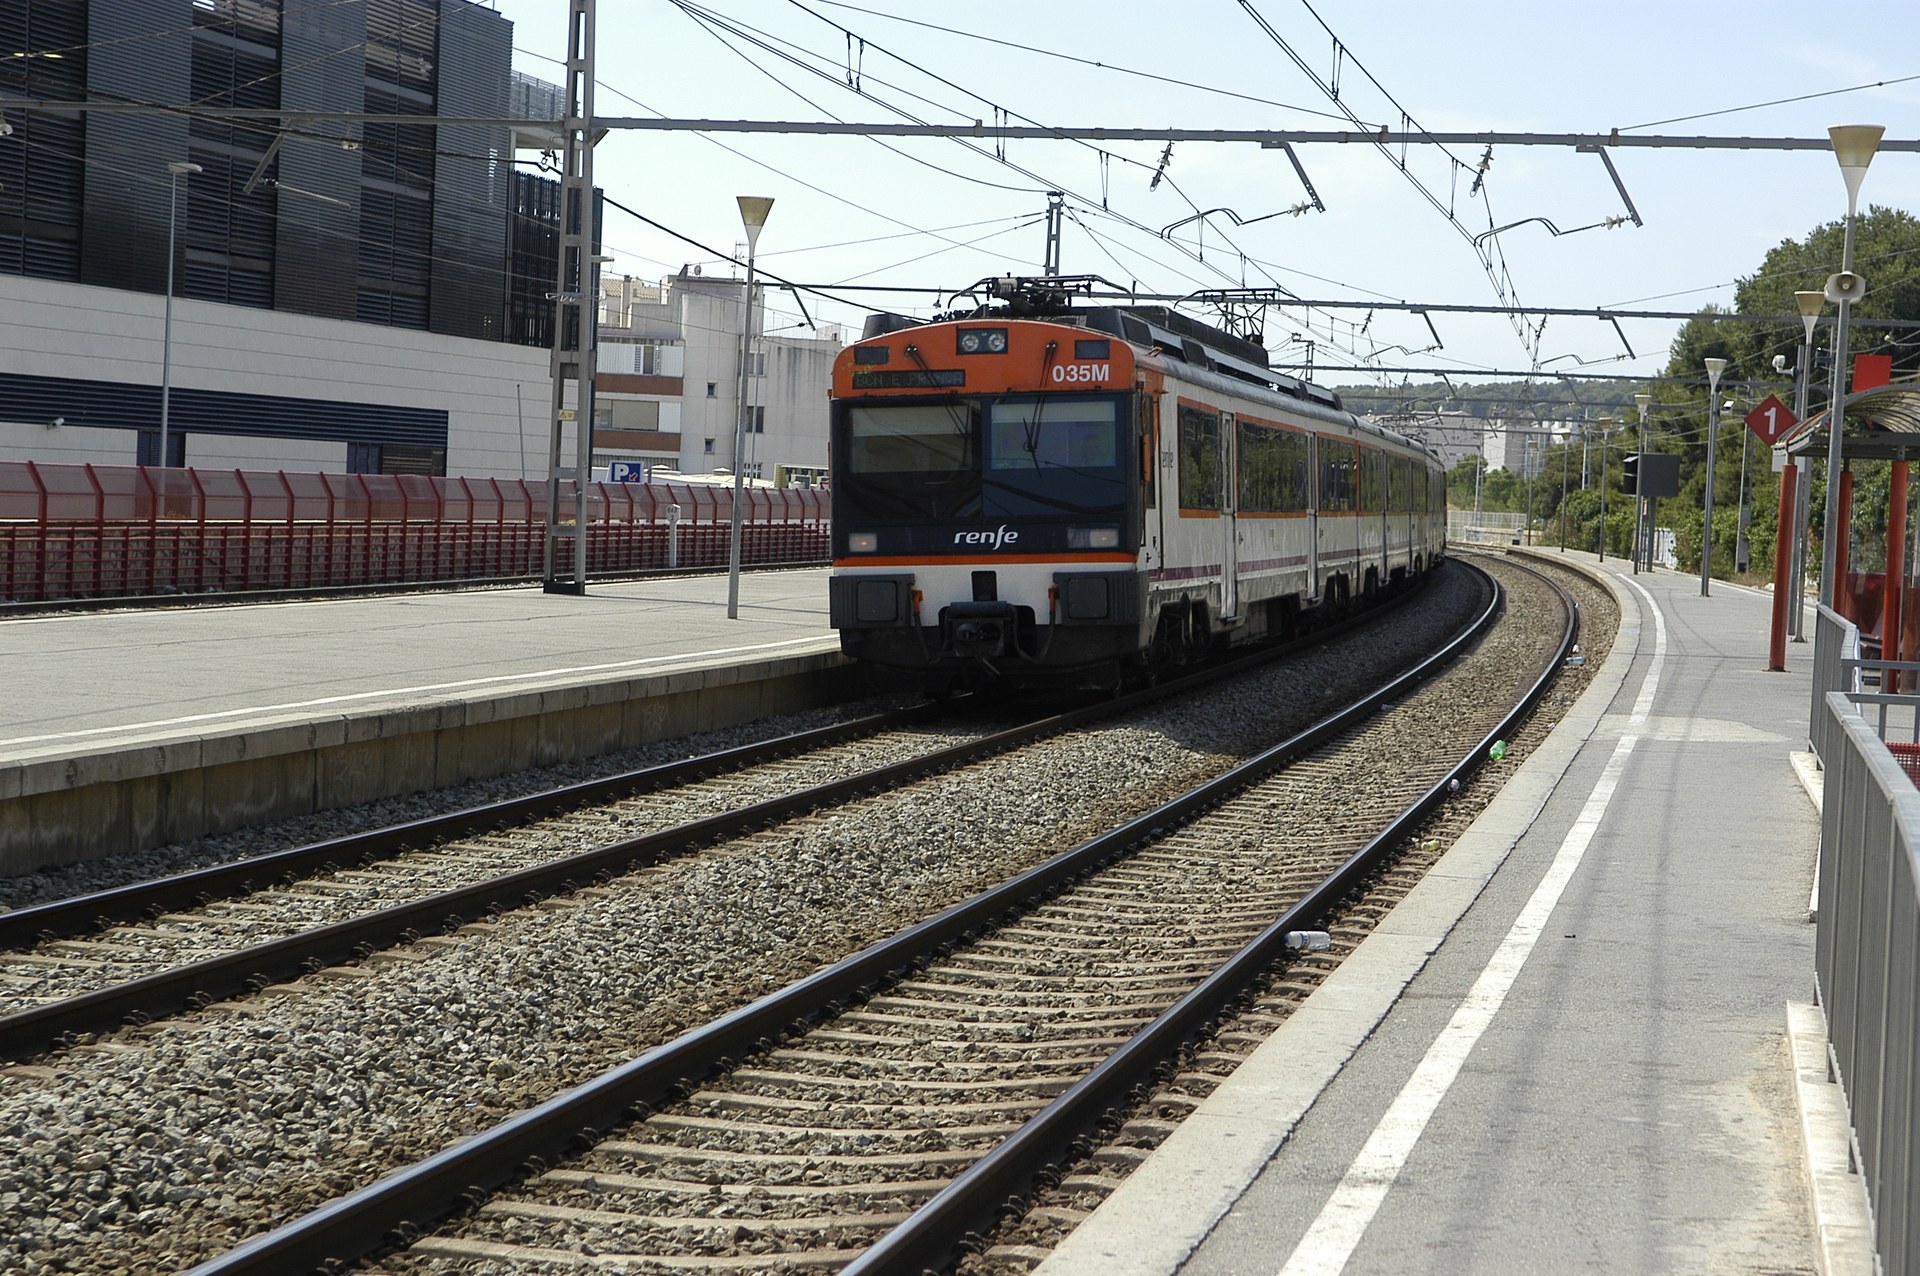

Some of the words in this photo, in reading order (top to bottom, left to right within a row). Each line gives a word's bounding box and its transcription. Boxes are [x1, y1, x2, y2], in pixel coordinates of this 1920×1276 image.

[1052, 364, 1110, 382] 035M
[1763, 406, 1777, 435] 1
[614, 463, 630, 481] P
[953, 524, 1019, 550] renfe
